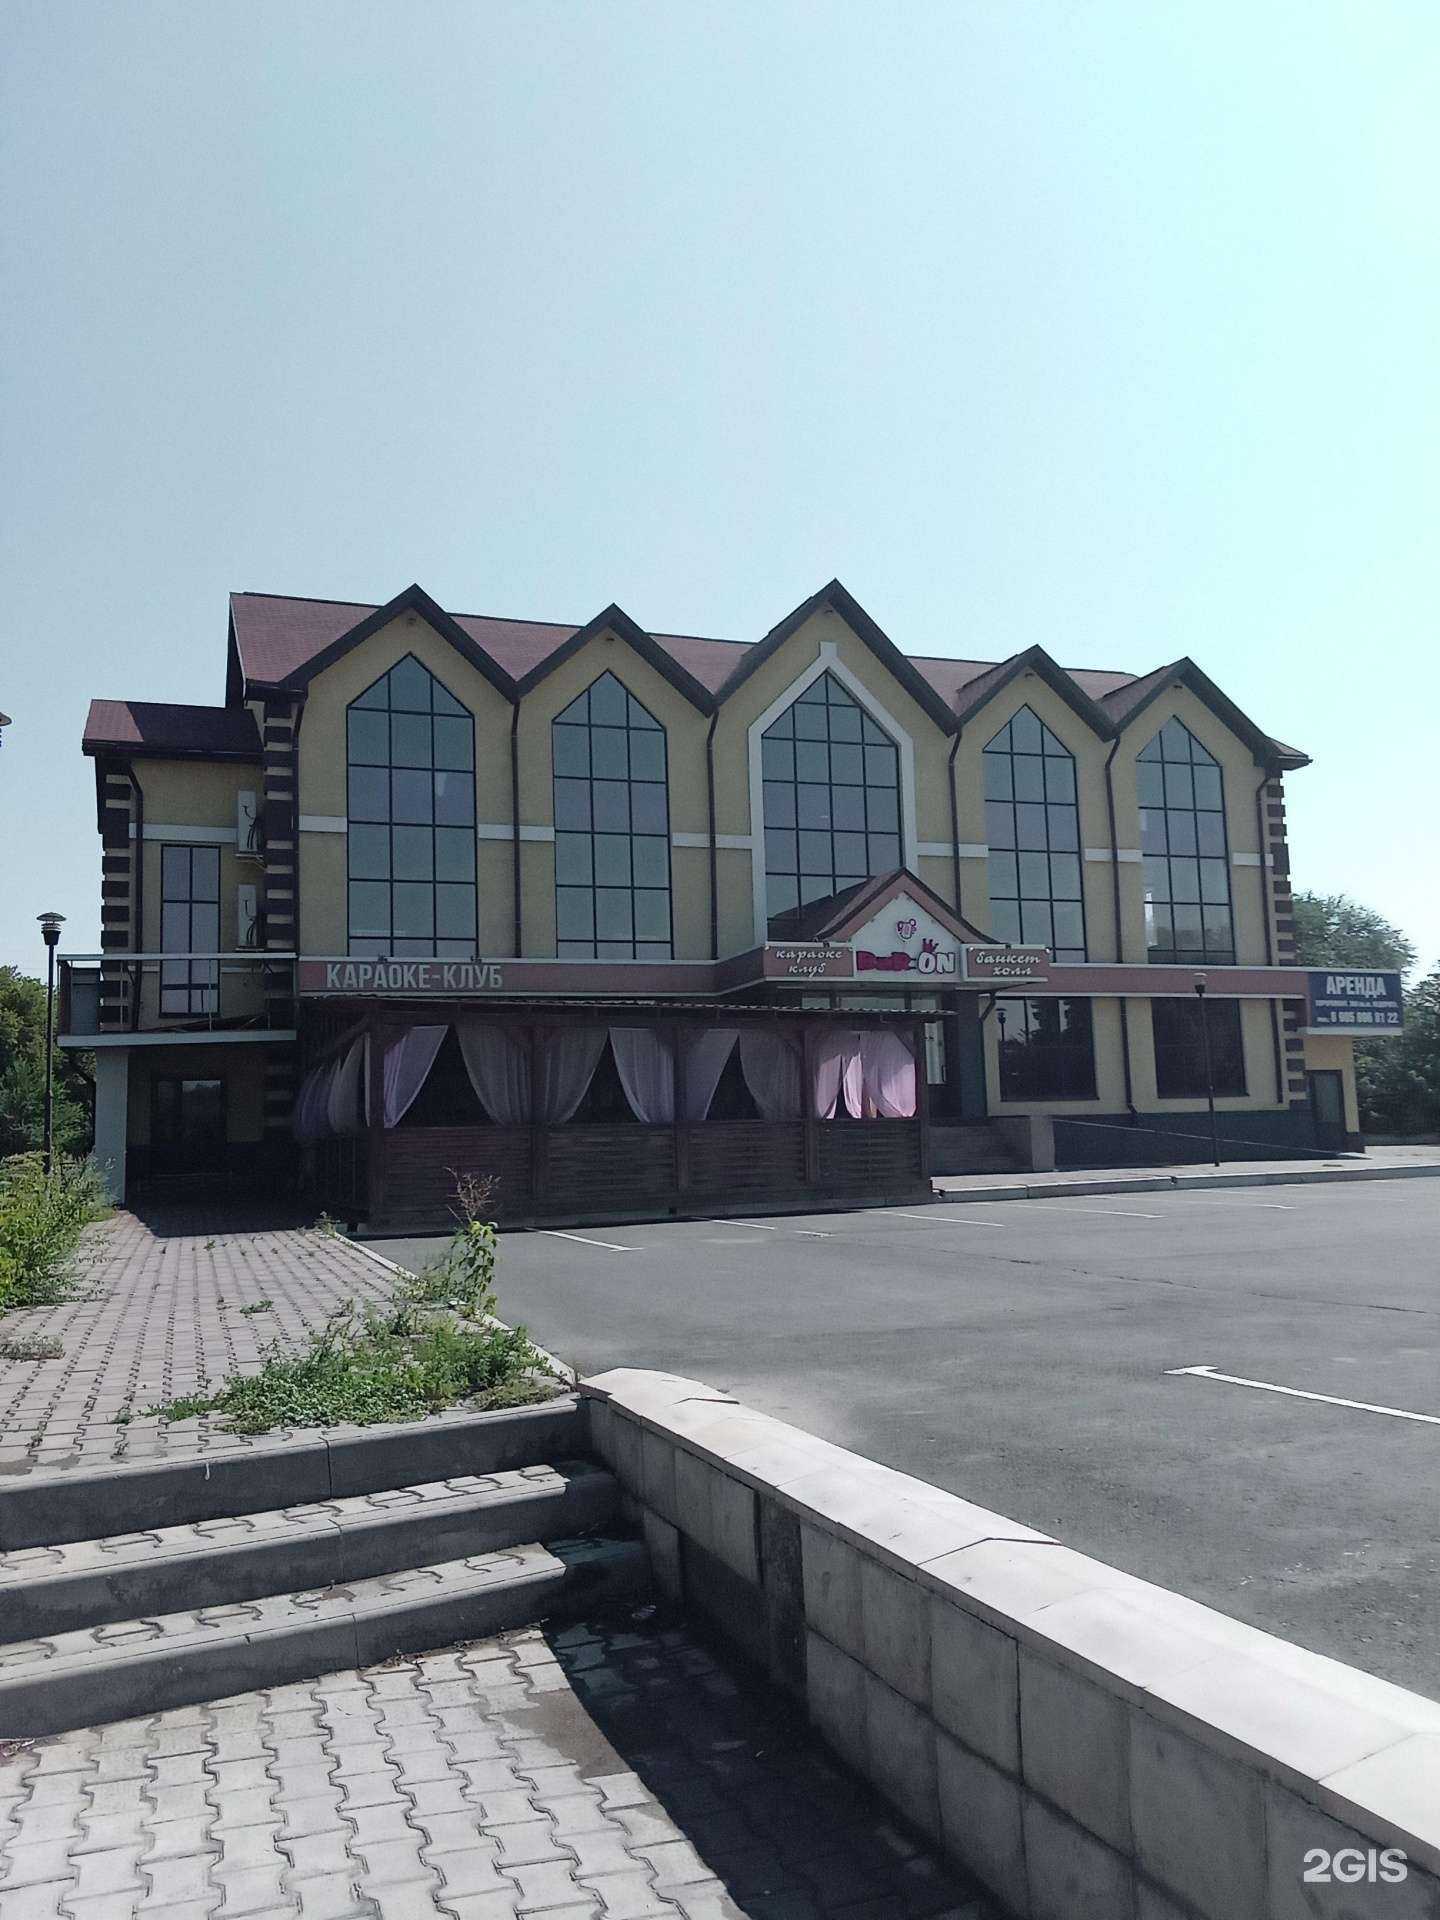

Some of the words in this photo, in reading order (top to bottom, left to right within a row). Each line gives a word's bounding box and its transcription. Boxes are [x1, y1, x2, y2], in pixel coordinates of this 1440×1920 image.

[326, 963, 504, 988] КАРАОКЕ-КЛУБ
[788, 962, 826, 978] клуб
[992, 966, 1033, 976] холл
[1326, 975, 1387, 998] АРЕНДА
